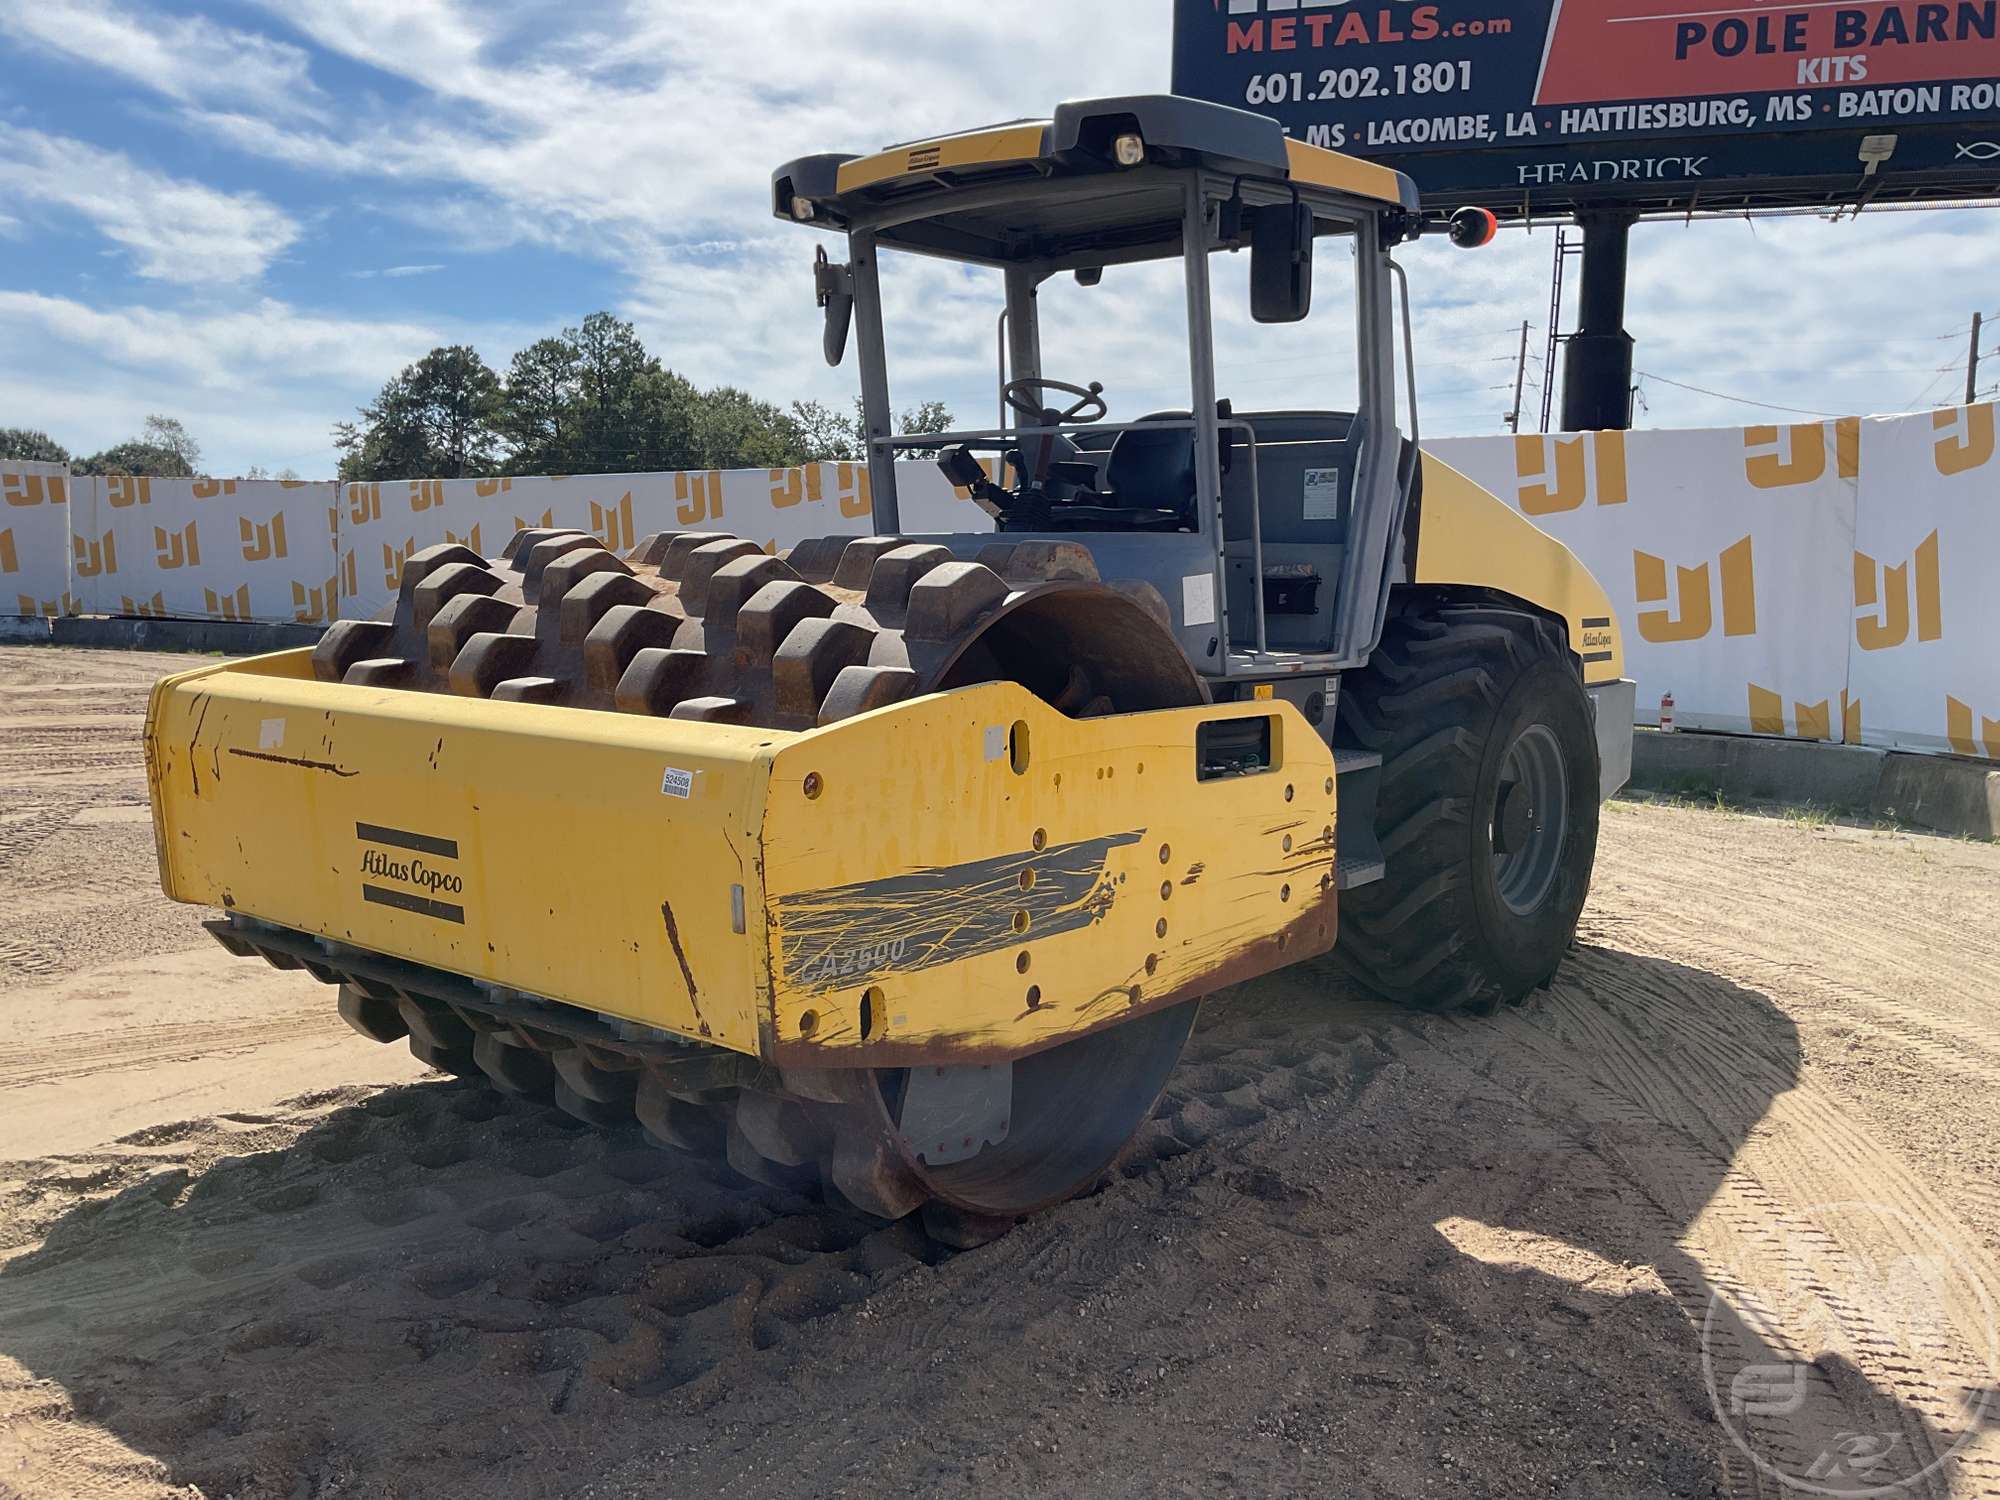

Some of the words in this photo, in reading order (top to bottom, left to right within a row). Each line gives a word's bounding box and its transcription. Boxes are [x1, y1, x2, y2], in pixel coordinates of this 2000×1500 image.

[1227, 6, 1512, 54] METALS.com
[1674, 13, 1810, 61] POLE
[1833, 1, 1997, 49] BARN
[1245, 60, 1473, 105] 601.202.1801
[1797, 55, 1868, 85] KITS
[1306, 123, 1346, 148] MS
[1367, 114, 1499, 146] LACOMBE,
[1505, 112, 1538, 137] LA
[1560, 99, 1758, 134] HATTIESBURG,
[1765, 94, 1813, 122] MS
[1838, 86, 1942, 119] BATON
[1517, 156, 1709, 184] HEADRICK
[665, 773, 690, 788] 524508
[360, 849, 409, 881] Atlas
[411, 859, 463, 894] Copco
